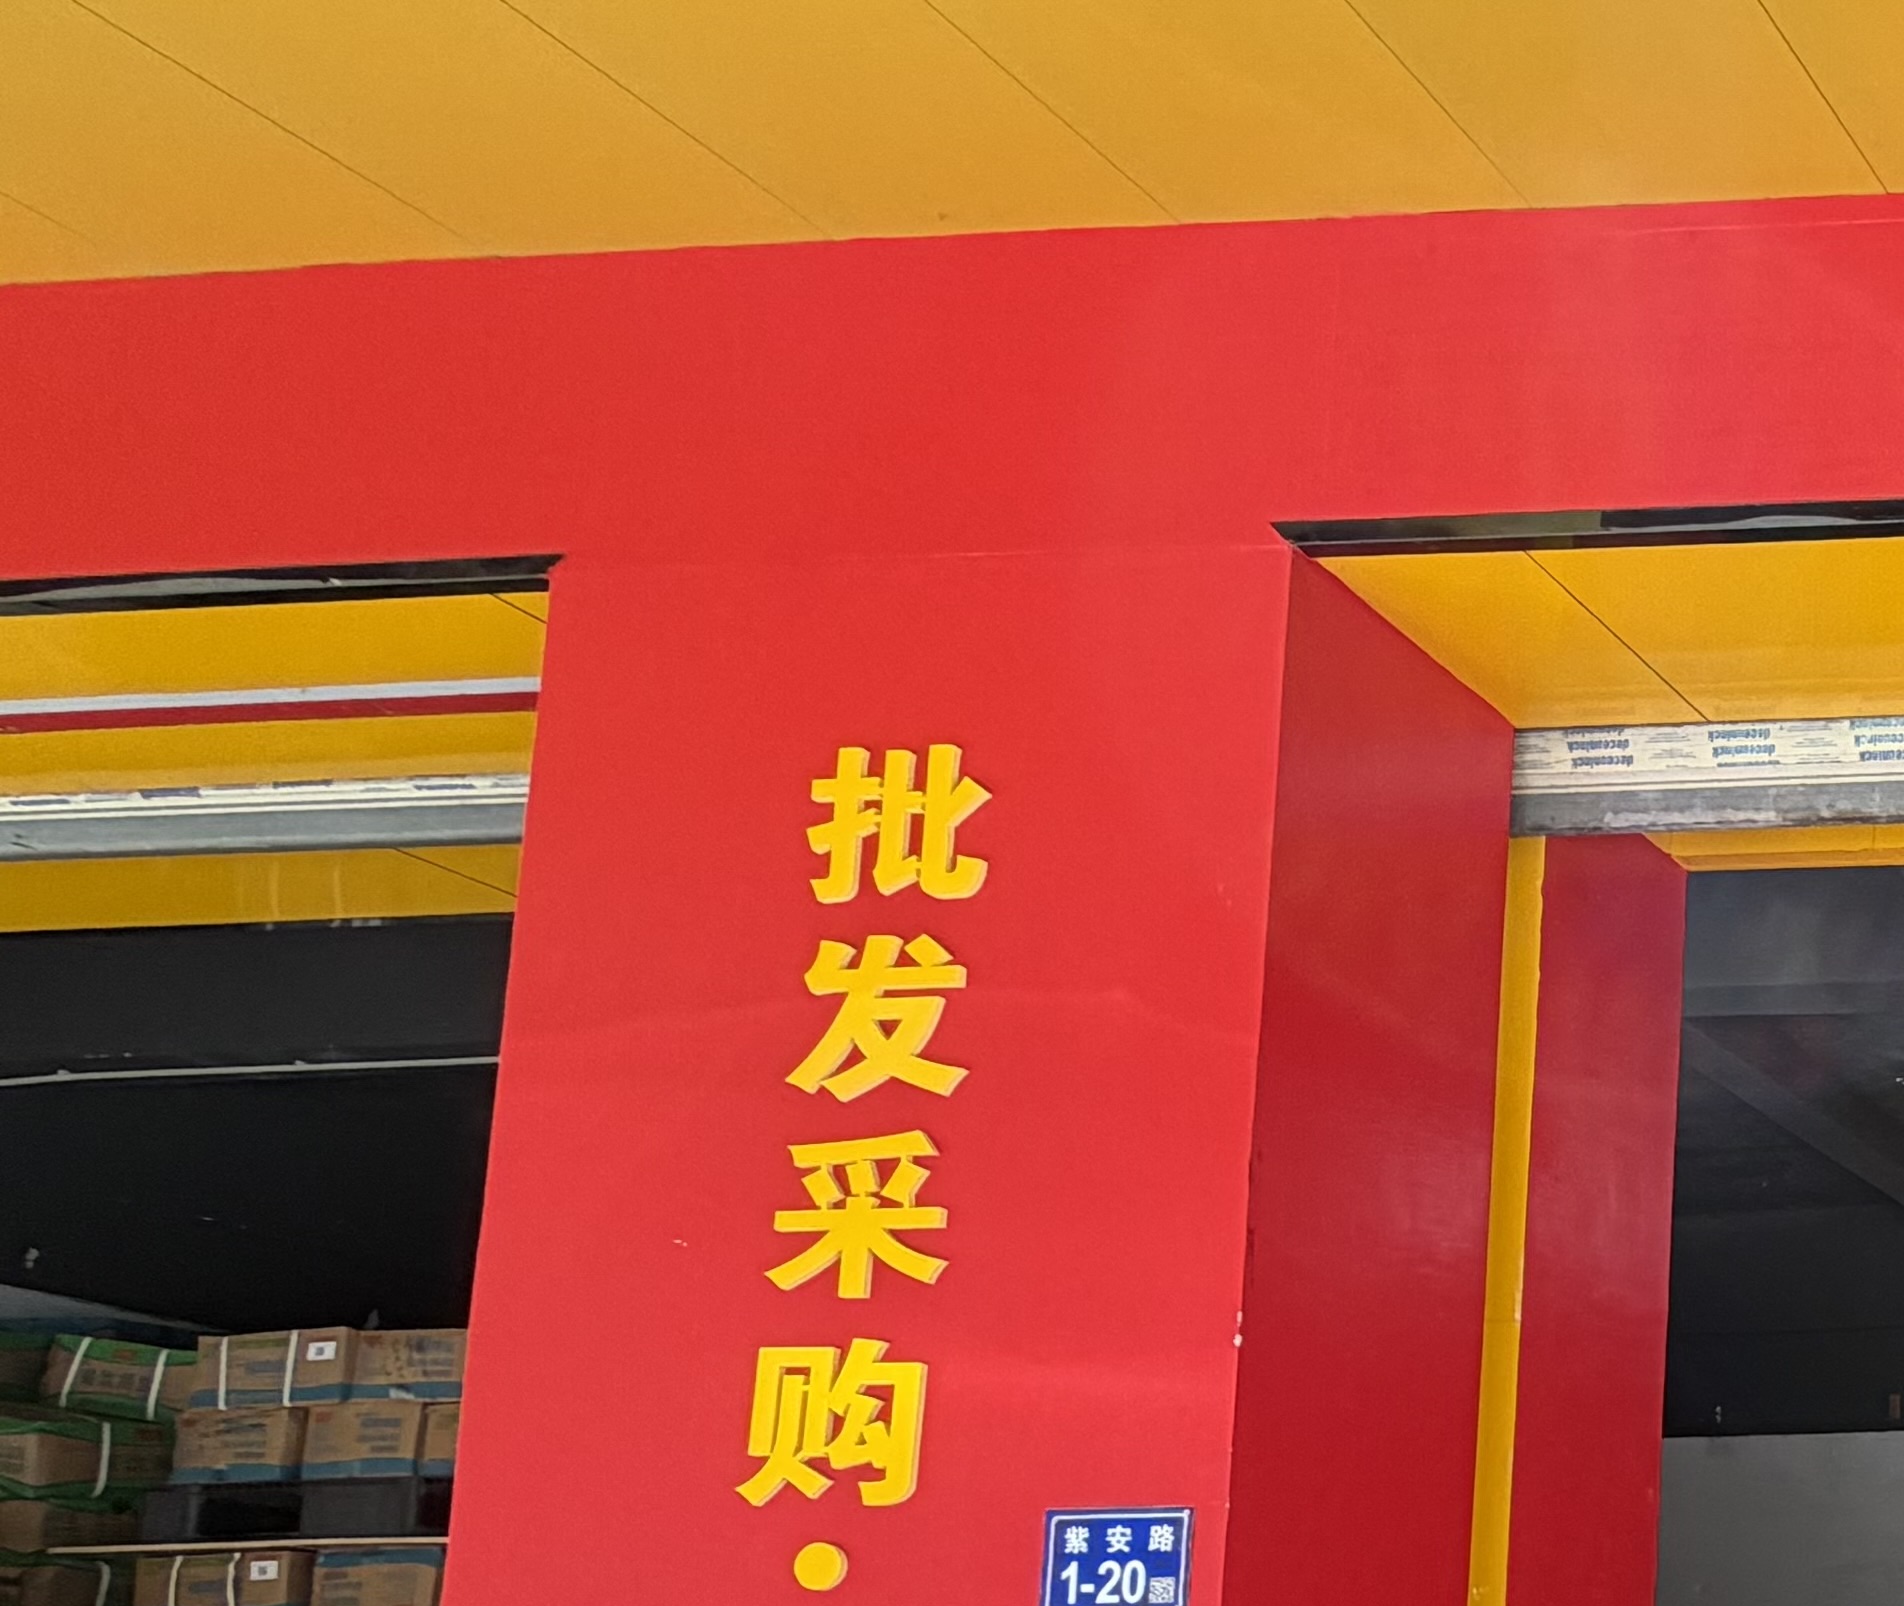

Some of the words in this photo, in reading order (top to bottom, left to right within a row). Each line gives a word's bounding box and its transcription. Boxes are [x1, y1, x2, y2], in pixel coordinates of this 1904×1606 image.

[1063, 1524, 1175, 1555] 紫安路
[1060, 1559, 1147, 1605] 1-20
